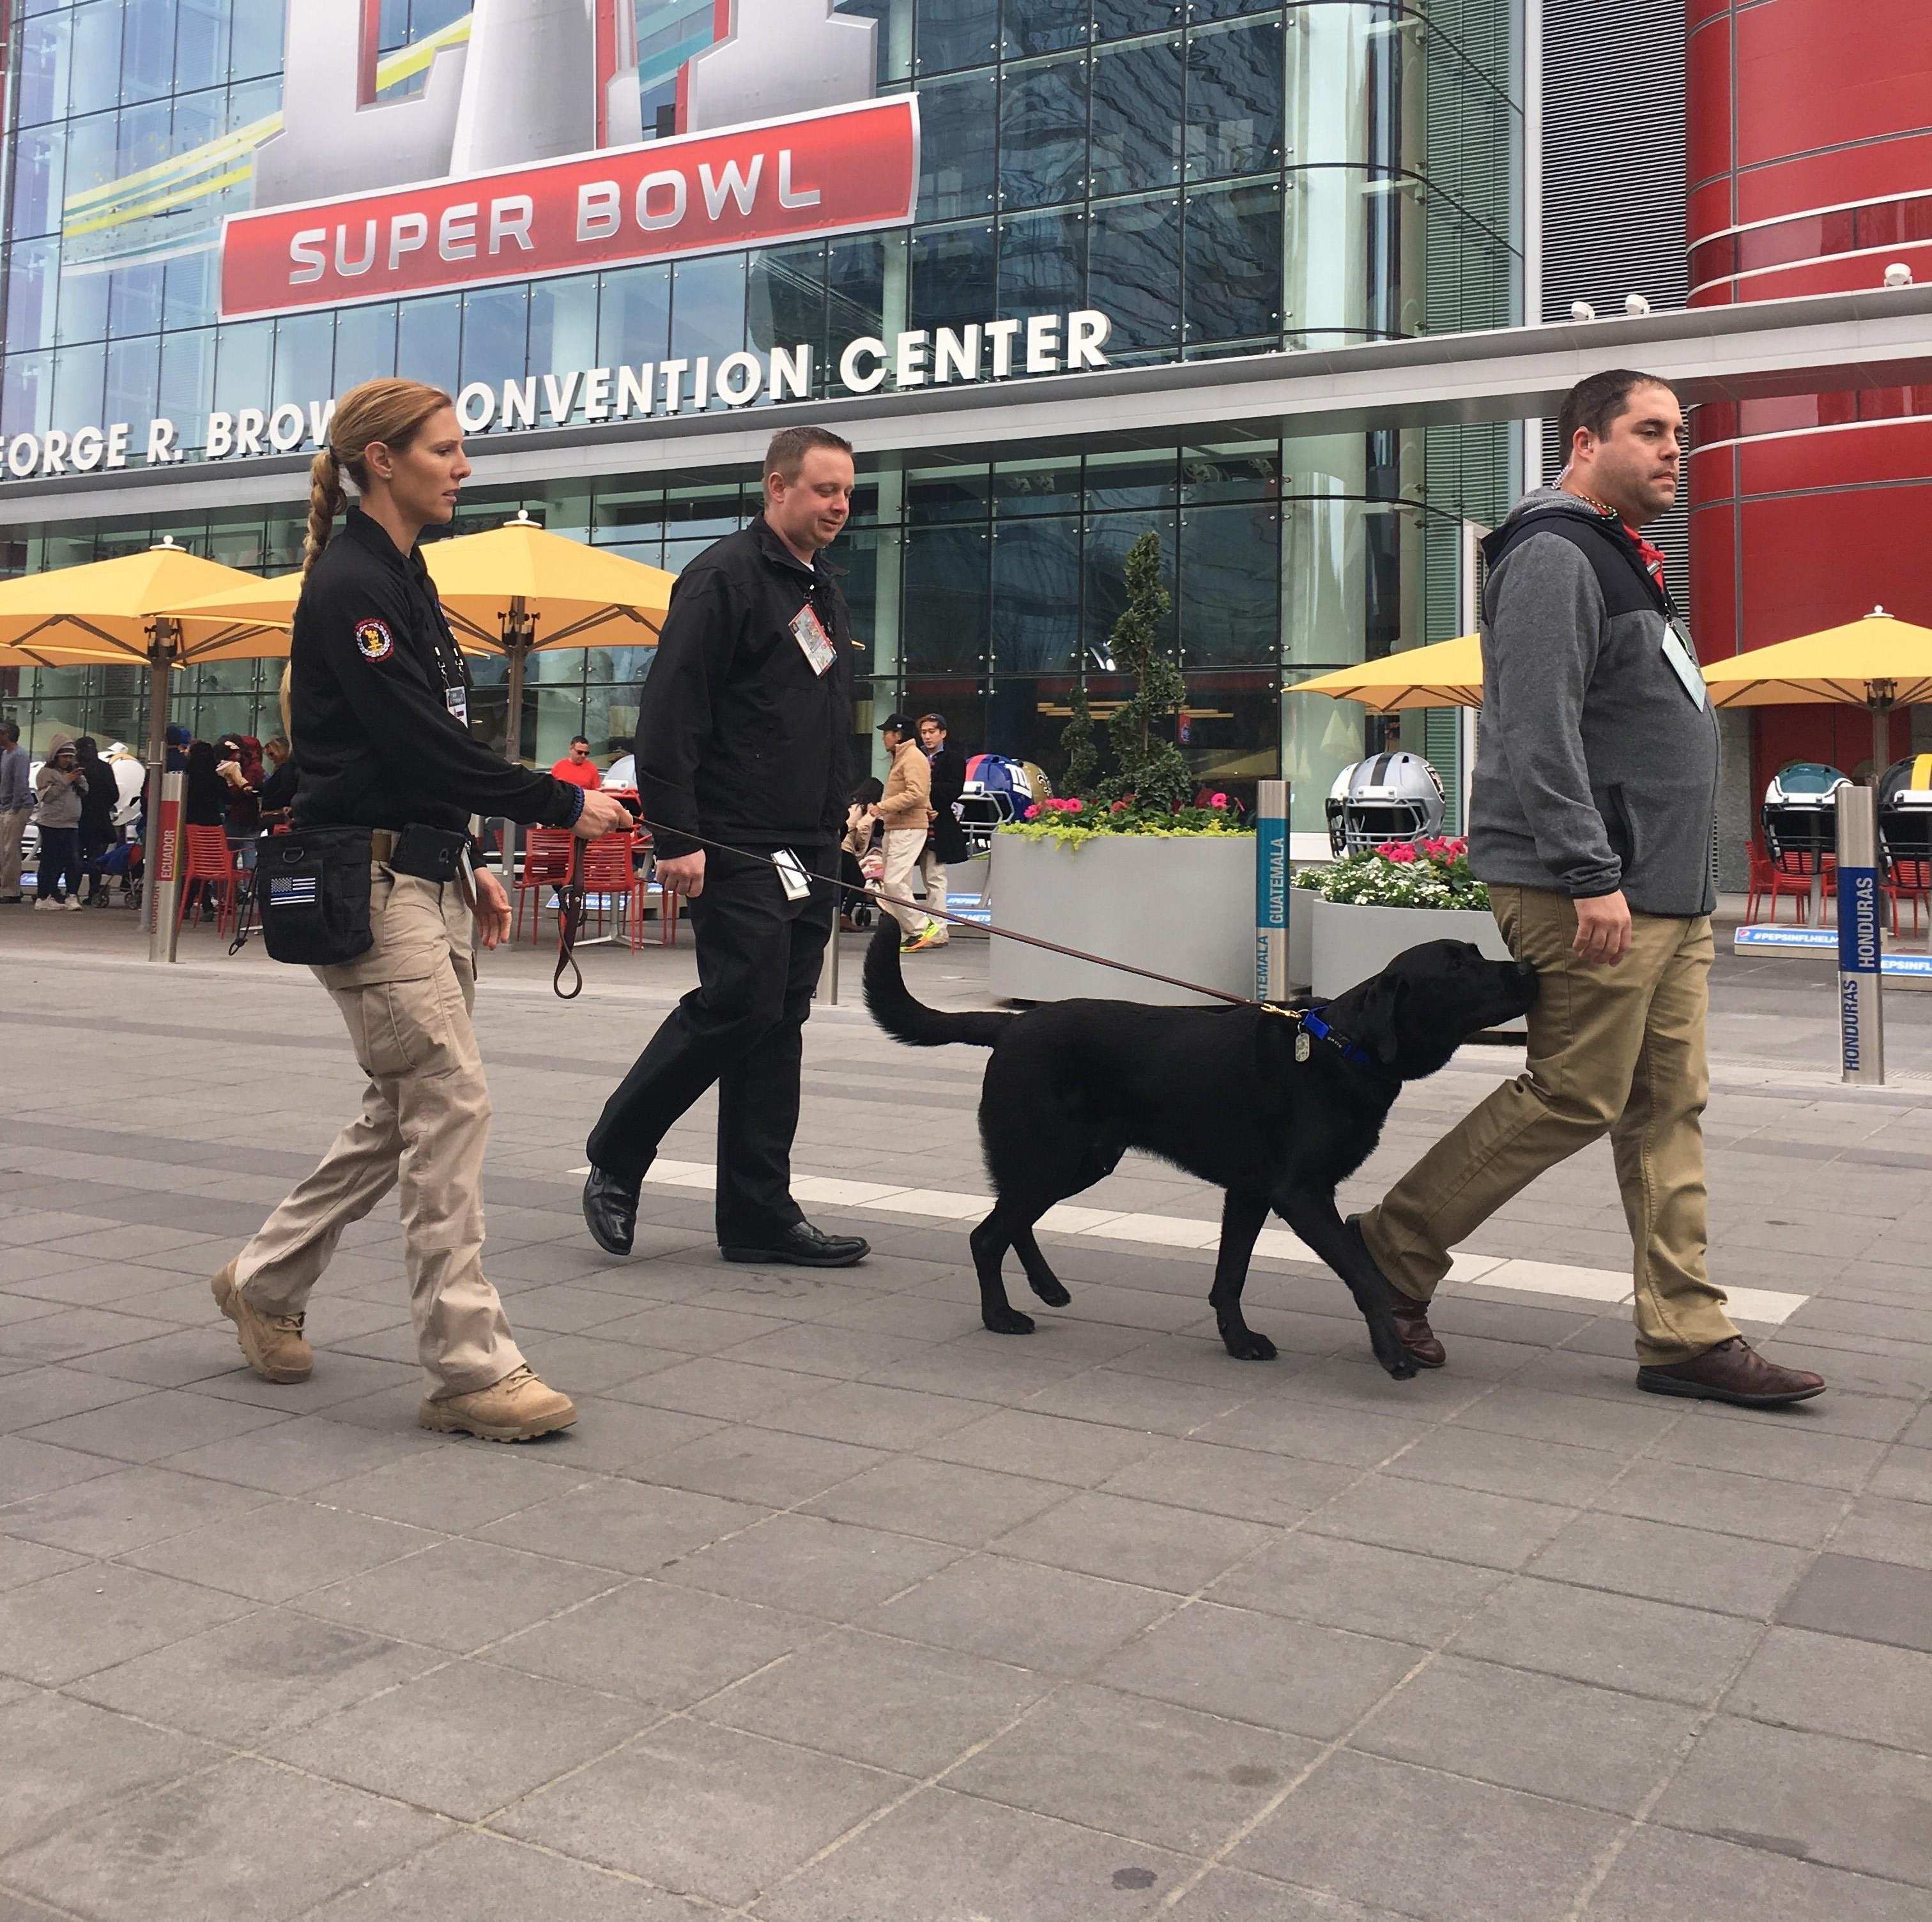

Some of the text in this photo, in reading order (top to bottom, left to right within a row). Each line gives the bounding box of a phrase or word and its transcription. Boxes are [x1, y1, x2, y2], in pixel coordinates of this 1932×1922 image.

[289, 149, 821, 285] SUPER BOWL
[0, 422, 133, 478] ORGE
[147, 418, 188, 463] R.
[456, 344, 814, 432] ONVENTION
[839, 309, 1112, 393] CENTER
[161, 829, 175, 878] ECUADOR
[1269, 837, 1285, 924] GUATEMALA
[1753, 933, 1839, 943] #PEPSINFLHELM
[1856, 877, 1875, 968] HONDURAS
[1257, 935, 1268, 1001] ATEMALA
[1843, 979, 1860, 1071] HONDURAS
